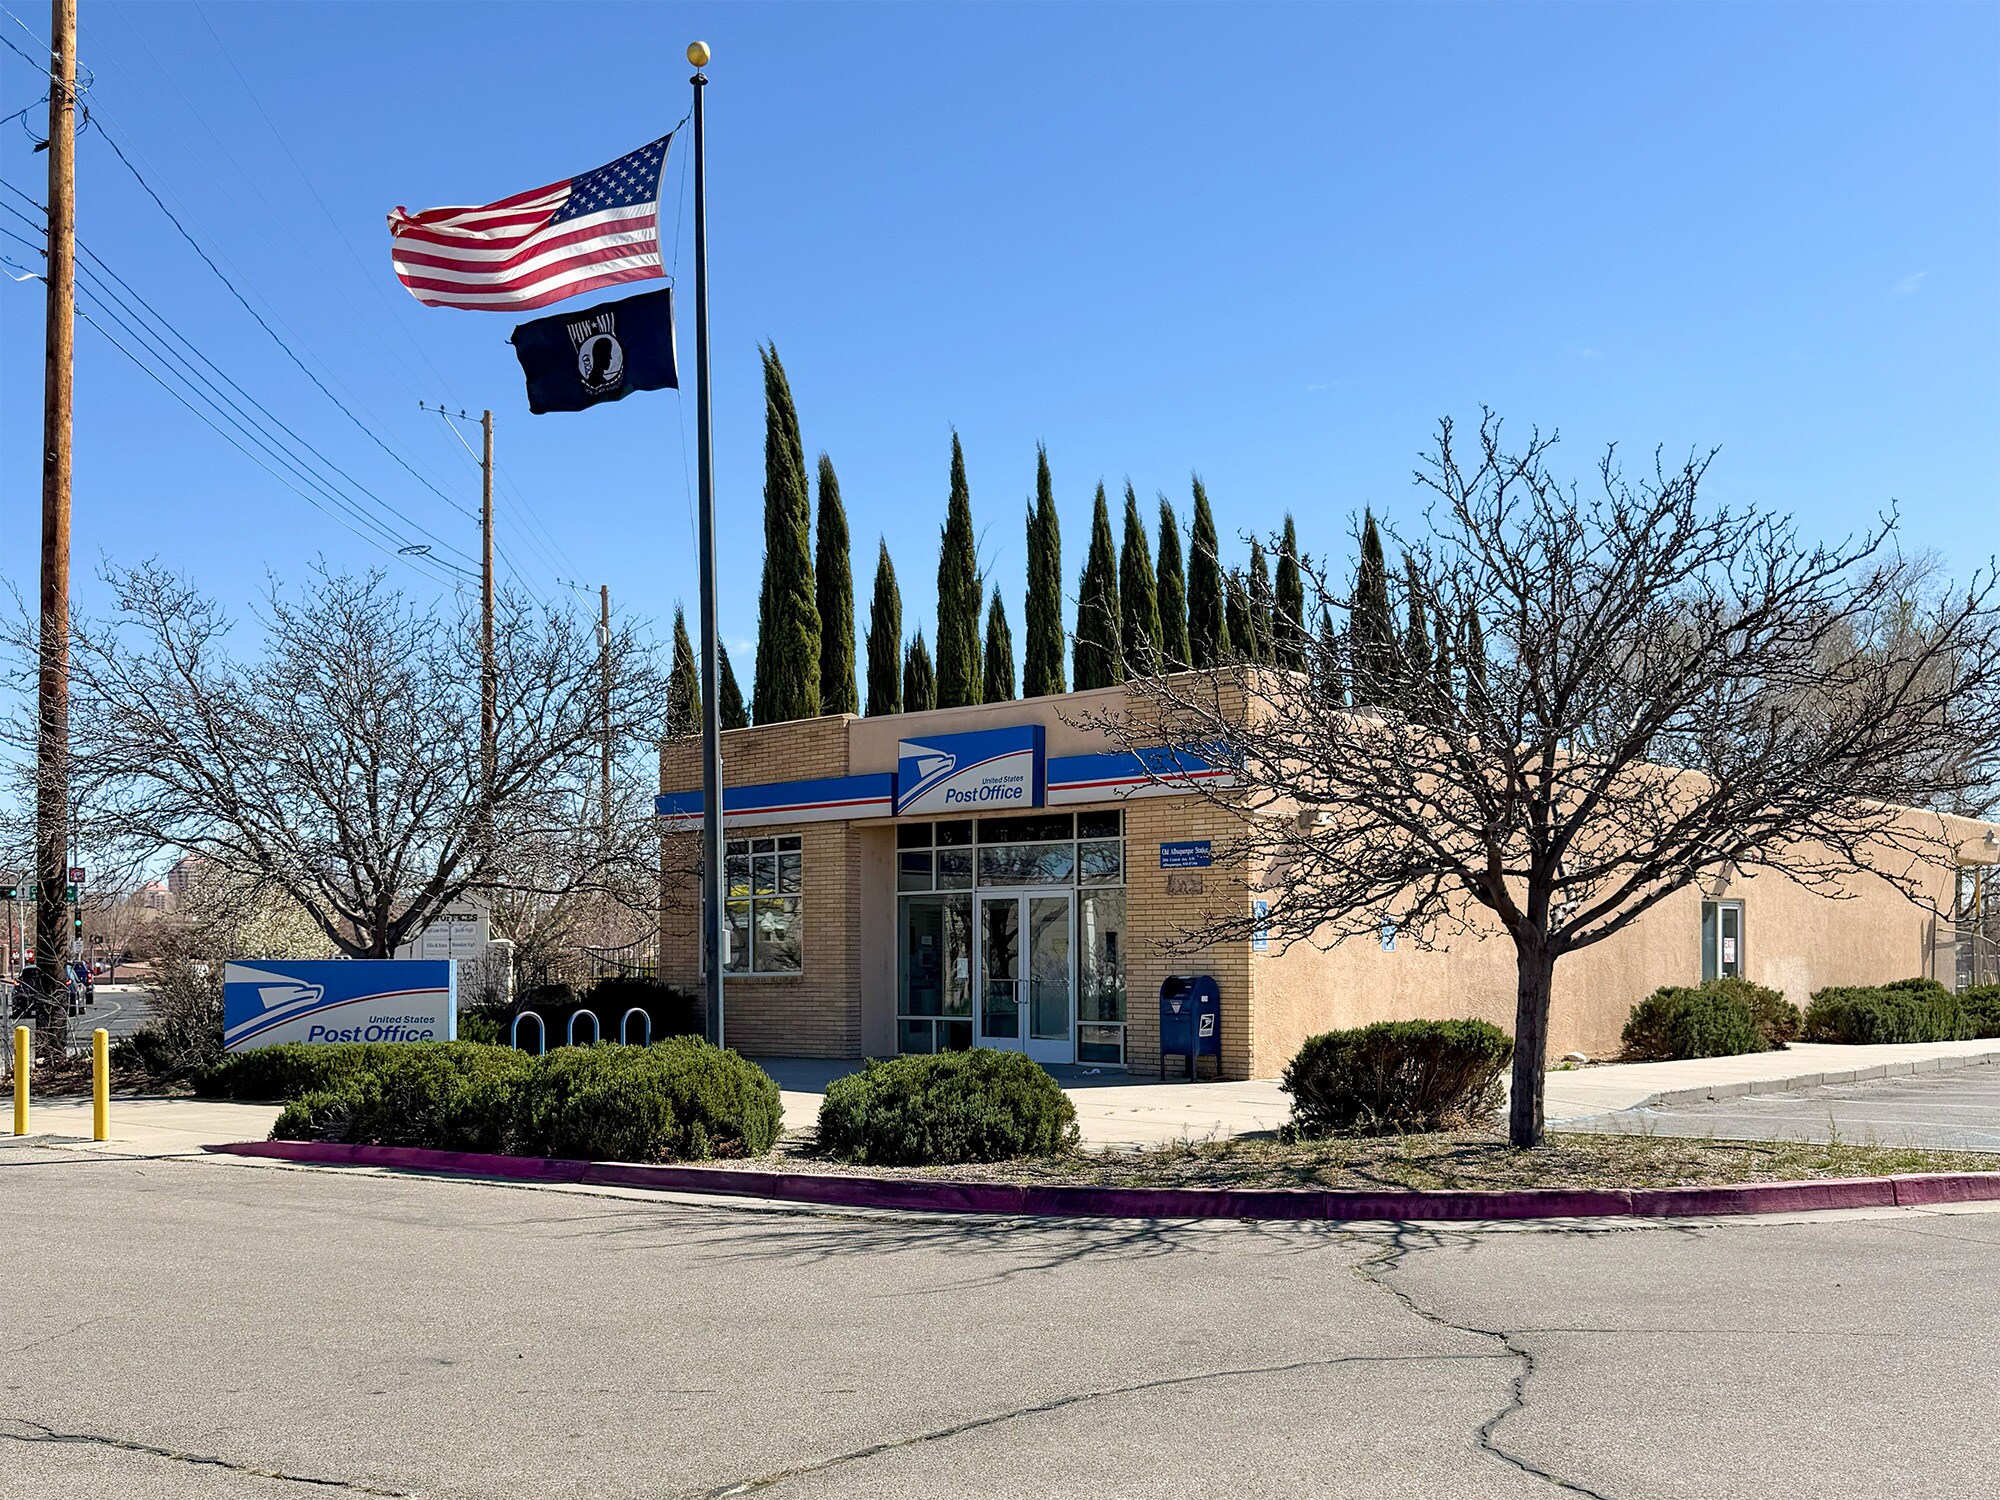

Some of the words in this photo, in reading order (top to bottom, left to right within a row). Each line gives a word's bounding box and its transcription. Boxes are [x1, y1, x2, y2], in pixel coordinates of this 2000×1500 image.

[945, 788, 978, 803] Post
[979, 785, 1023, 801] Office
[440, 914, 478, 922] OFFICES
[369, 1015, 401, 1024] United
[403, 1015, 435, 1024] States
[308, 1025, 362, 1043] Post
[364, 1025, 434, 1043] Office
